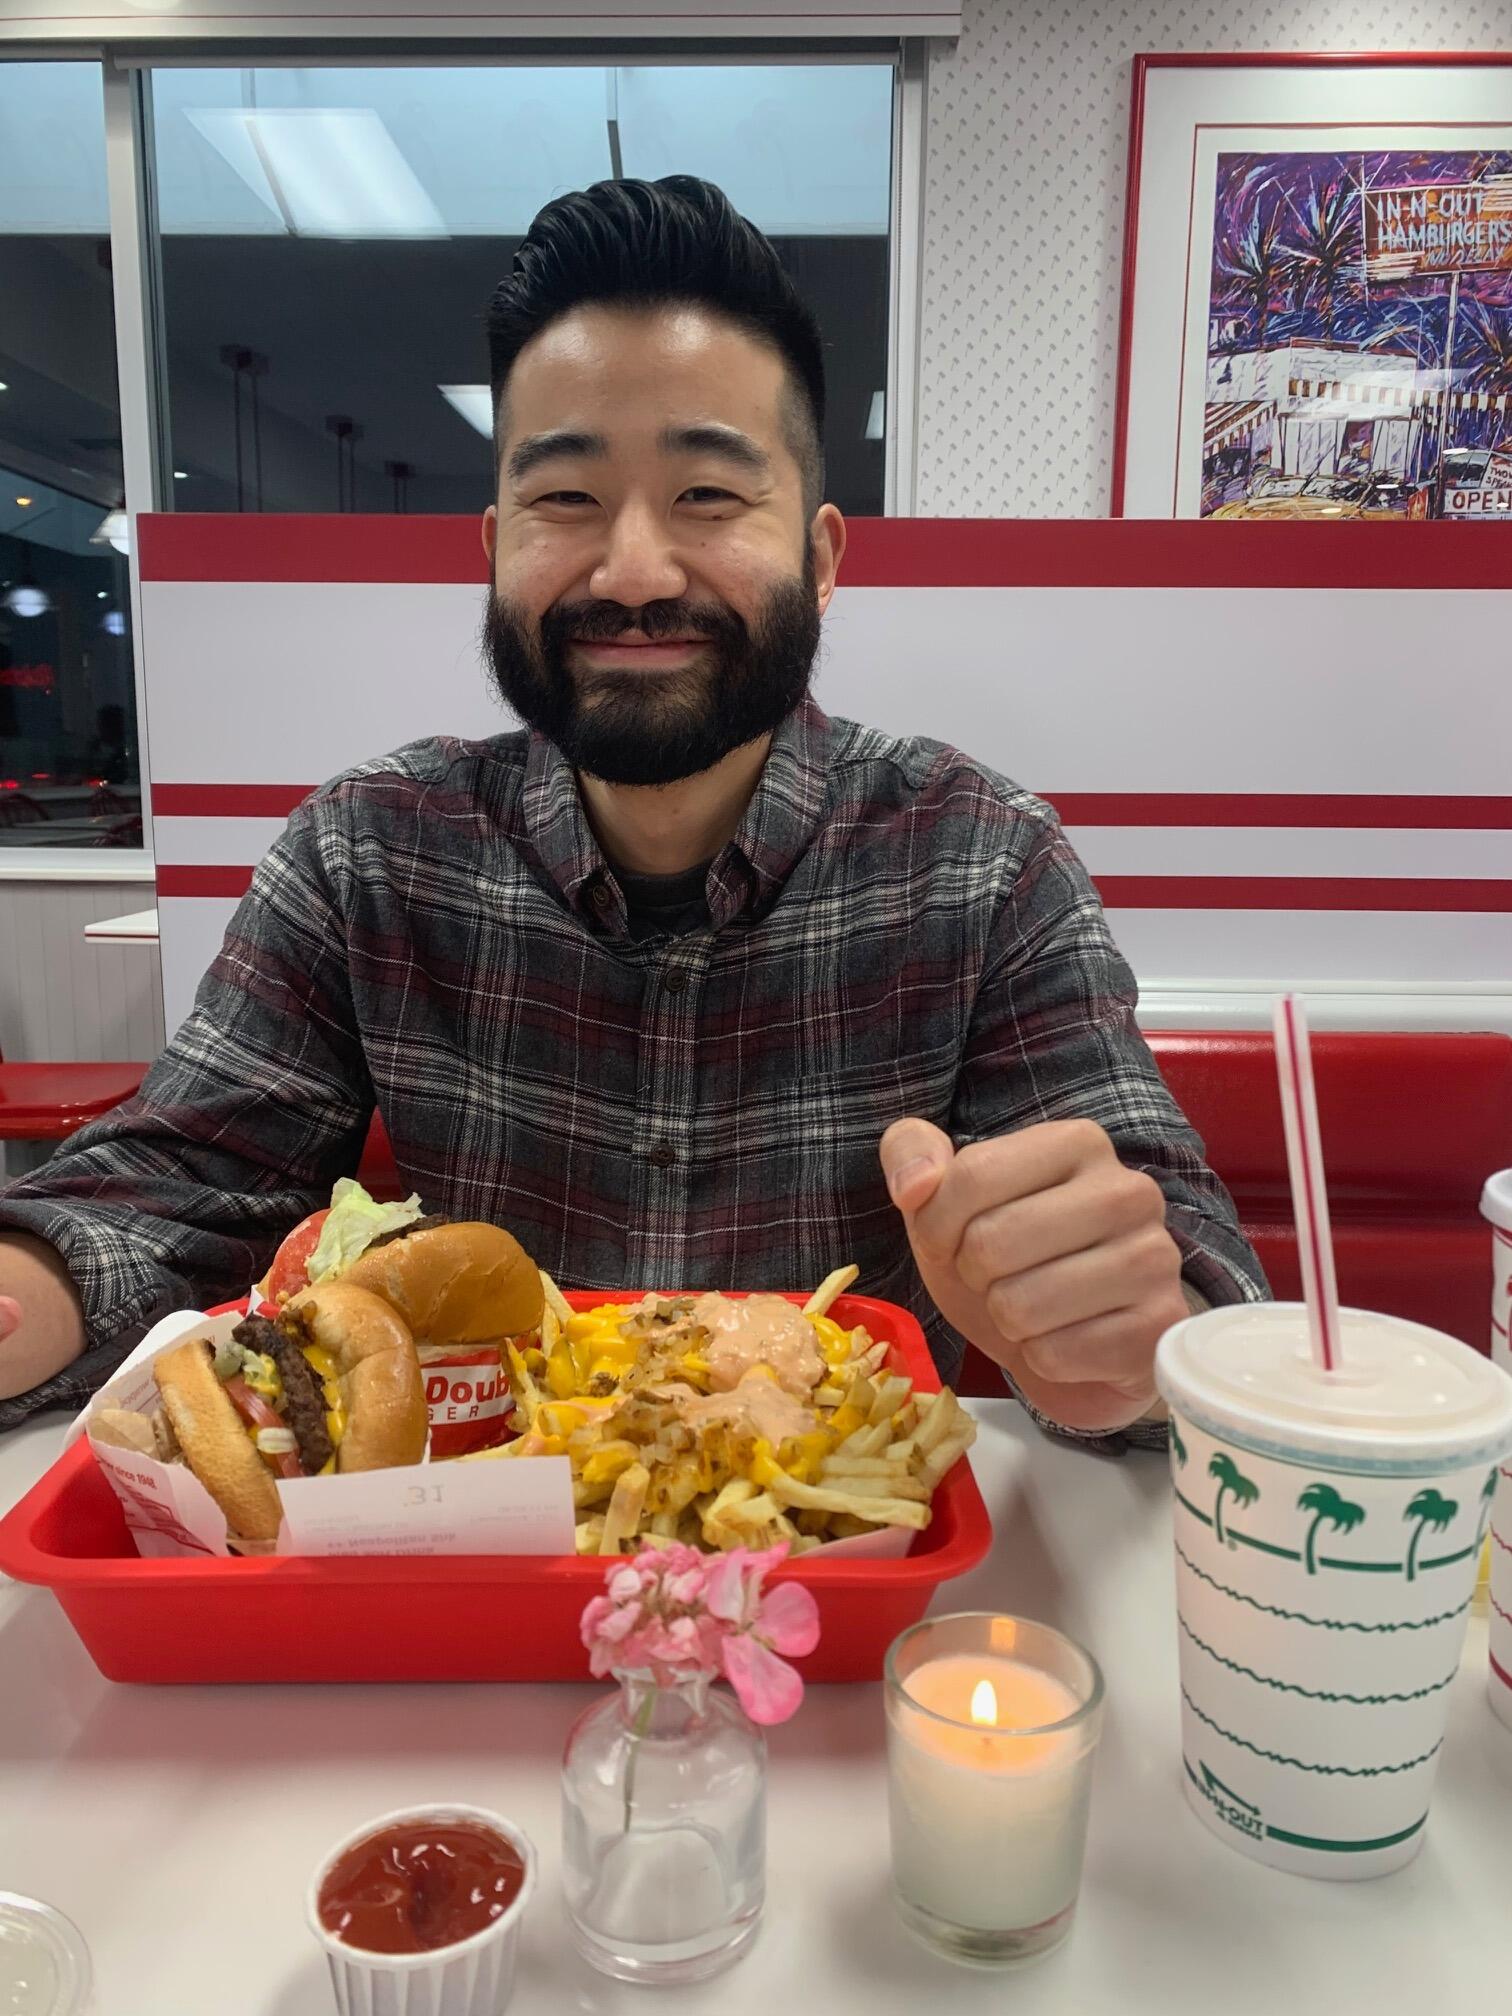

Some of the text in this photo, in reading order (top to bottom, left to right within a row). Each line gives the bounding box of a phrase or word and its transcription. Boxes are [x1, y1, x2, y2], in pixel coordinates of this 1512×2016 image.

[1377, 219, 1512, 251] HAMBURGERS
[1452, 491, 1512, 510] OPEN
[426, 1371, 510, 1405] Doub
